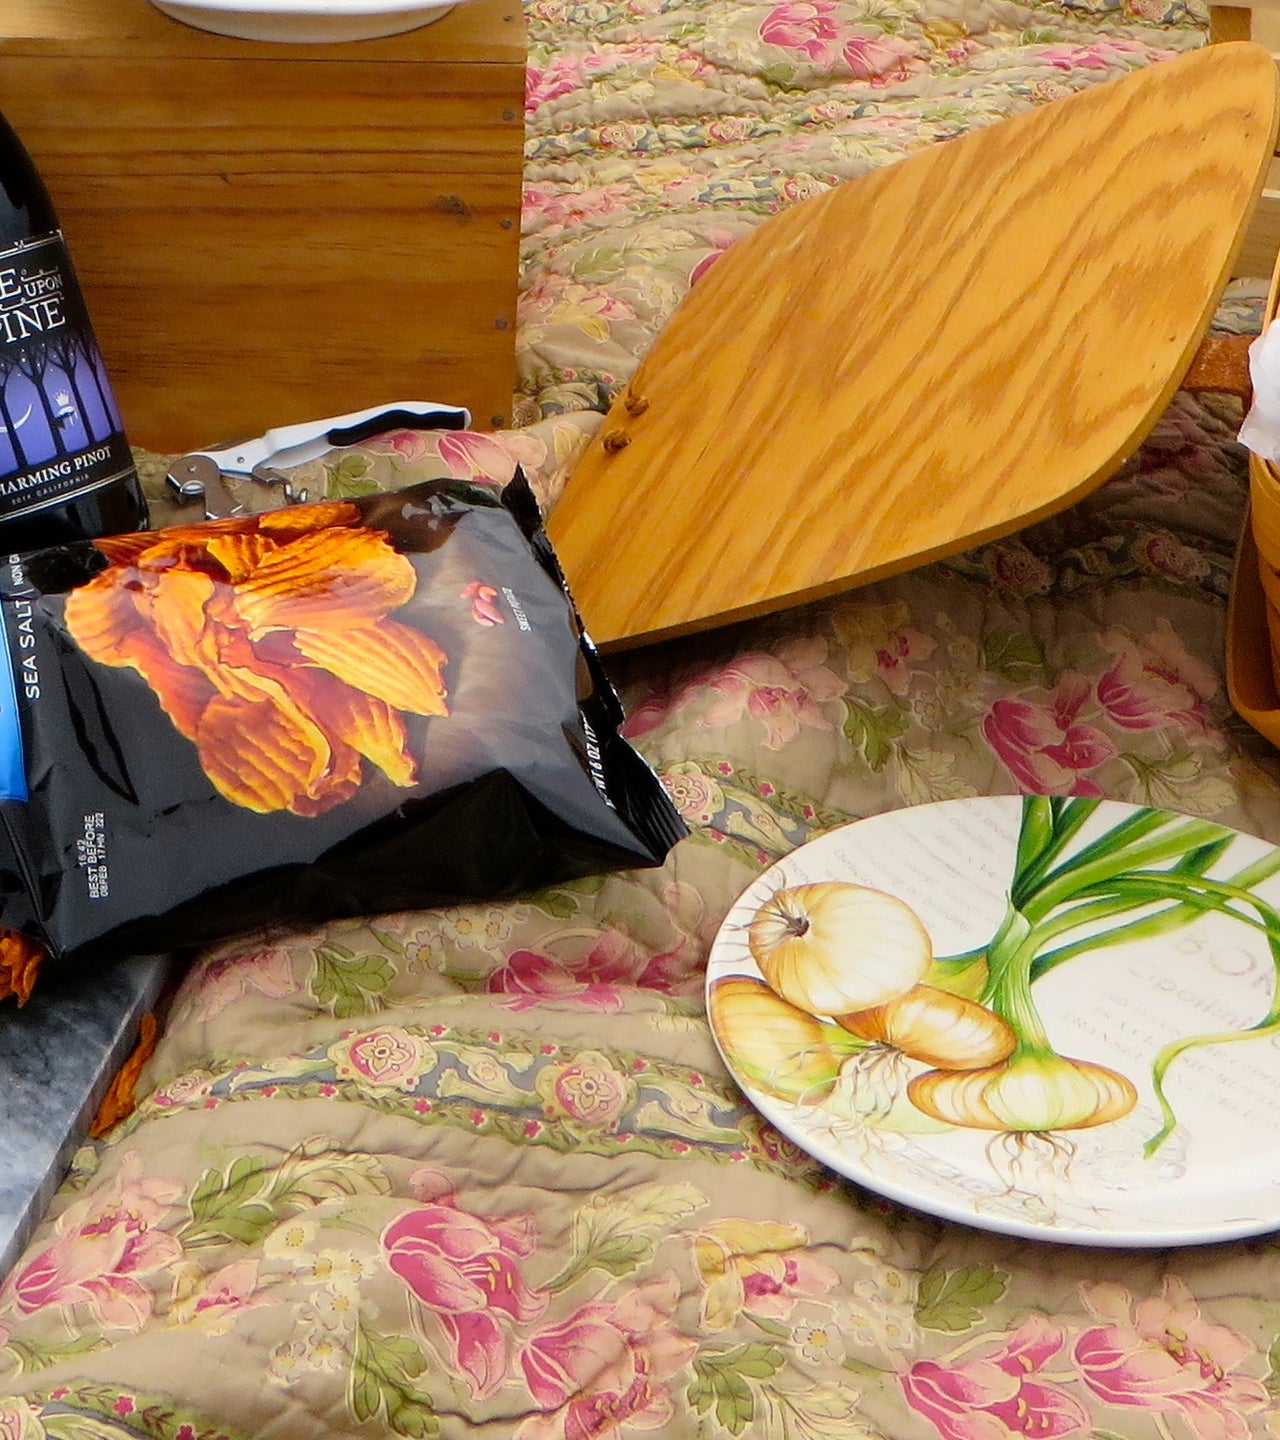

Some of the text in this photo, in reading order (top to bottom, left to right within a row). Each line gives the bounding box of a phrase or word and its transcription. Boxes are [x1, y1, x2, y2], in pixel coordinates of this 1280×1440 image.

[24, 272, 64, 299] UPON
[73, 445, 112, 471] PINOT
[36, 473, 91, 498] CALIFORNIA
[14, 599, 36, 649] SALT
[22, 654, 41, 700] SEA
[586, 742, 601, 760] OZ
[84, 814, 99, 898] BEST BEFORE
